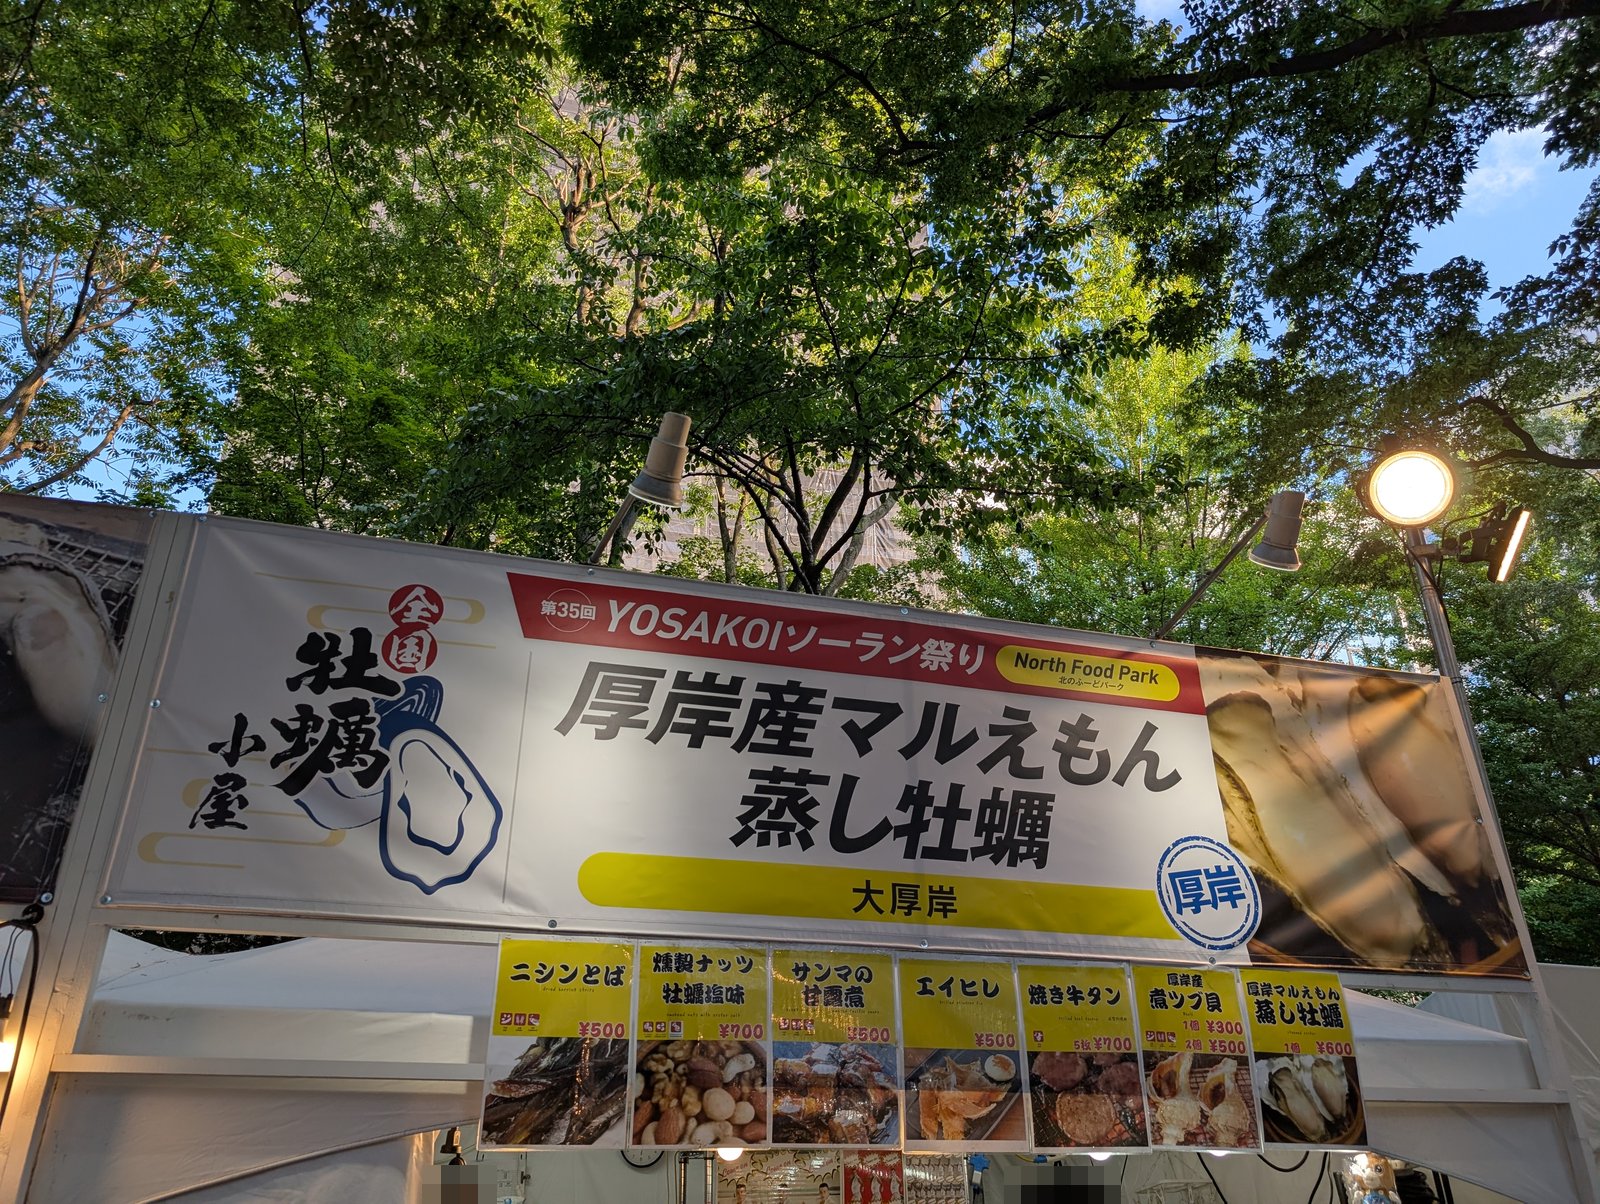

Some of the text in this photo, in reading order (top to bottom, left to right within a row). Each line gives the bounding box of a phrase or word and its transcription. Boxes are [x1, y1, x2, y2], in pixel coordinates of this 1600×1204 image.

[541, 600, 596, 620] 第35回
[390, 586, 439, 673] 全国
[607, 599, 985, 675] YOSAKOIソーラン祭り
[1014, 652, 1160, 685] North Food Park
[554, 661, 1183, 792] 厚岸産マルえもん
[189, 713, 267, 830] 小屋
[729, 766, 1056, 869] 蒸し牡蠣
[852, 879, 958, 919] 大厚岸
[1170, 864, 1247, 915] 厚岸
[510, 962, 626, 987] ニシンとば
[792, 962, 873, 984] サンマの
[1167, 973, 1203, 988] 厚岸産
[663, 983, 745, 1005] 牡蠣塩味
[802, 984, 865, 1008] 甘露煮
[1028, 984, 1121, 1006] 焼き牛タン
[1149, 988, 1223, 1013] 煮ツブ貝
[1246, 981, 1340, 1001] 厚岸マルえもん
[1254, 999, 1344, 1028] 蒸し牡蠣
[579, 1022, 625, 1038] ¥500
[719, 1023, 764, 1039] ¥700
[847, 1027, 890, 1042] ¥500
[1182, 1020, 1243, 1035] 1個 ¥300
[974, 1032, 1016, 1047] ¥500
[1093, 1037, 1132, 1051] ¥700
[1209, 1039, 1246, 1054] ¥500
[1316, 1040, 1352, 1055] ¥600
